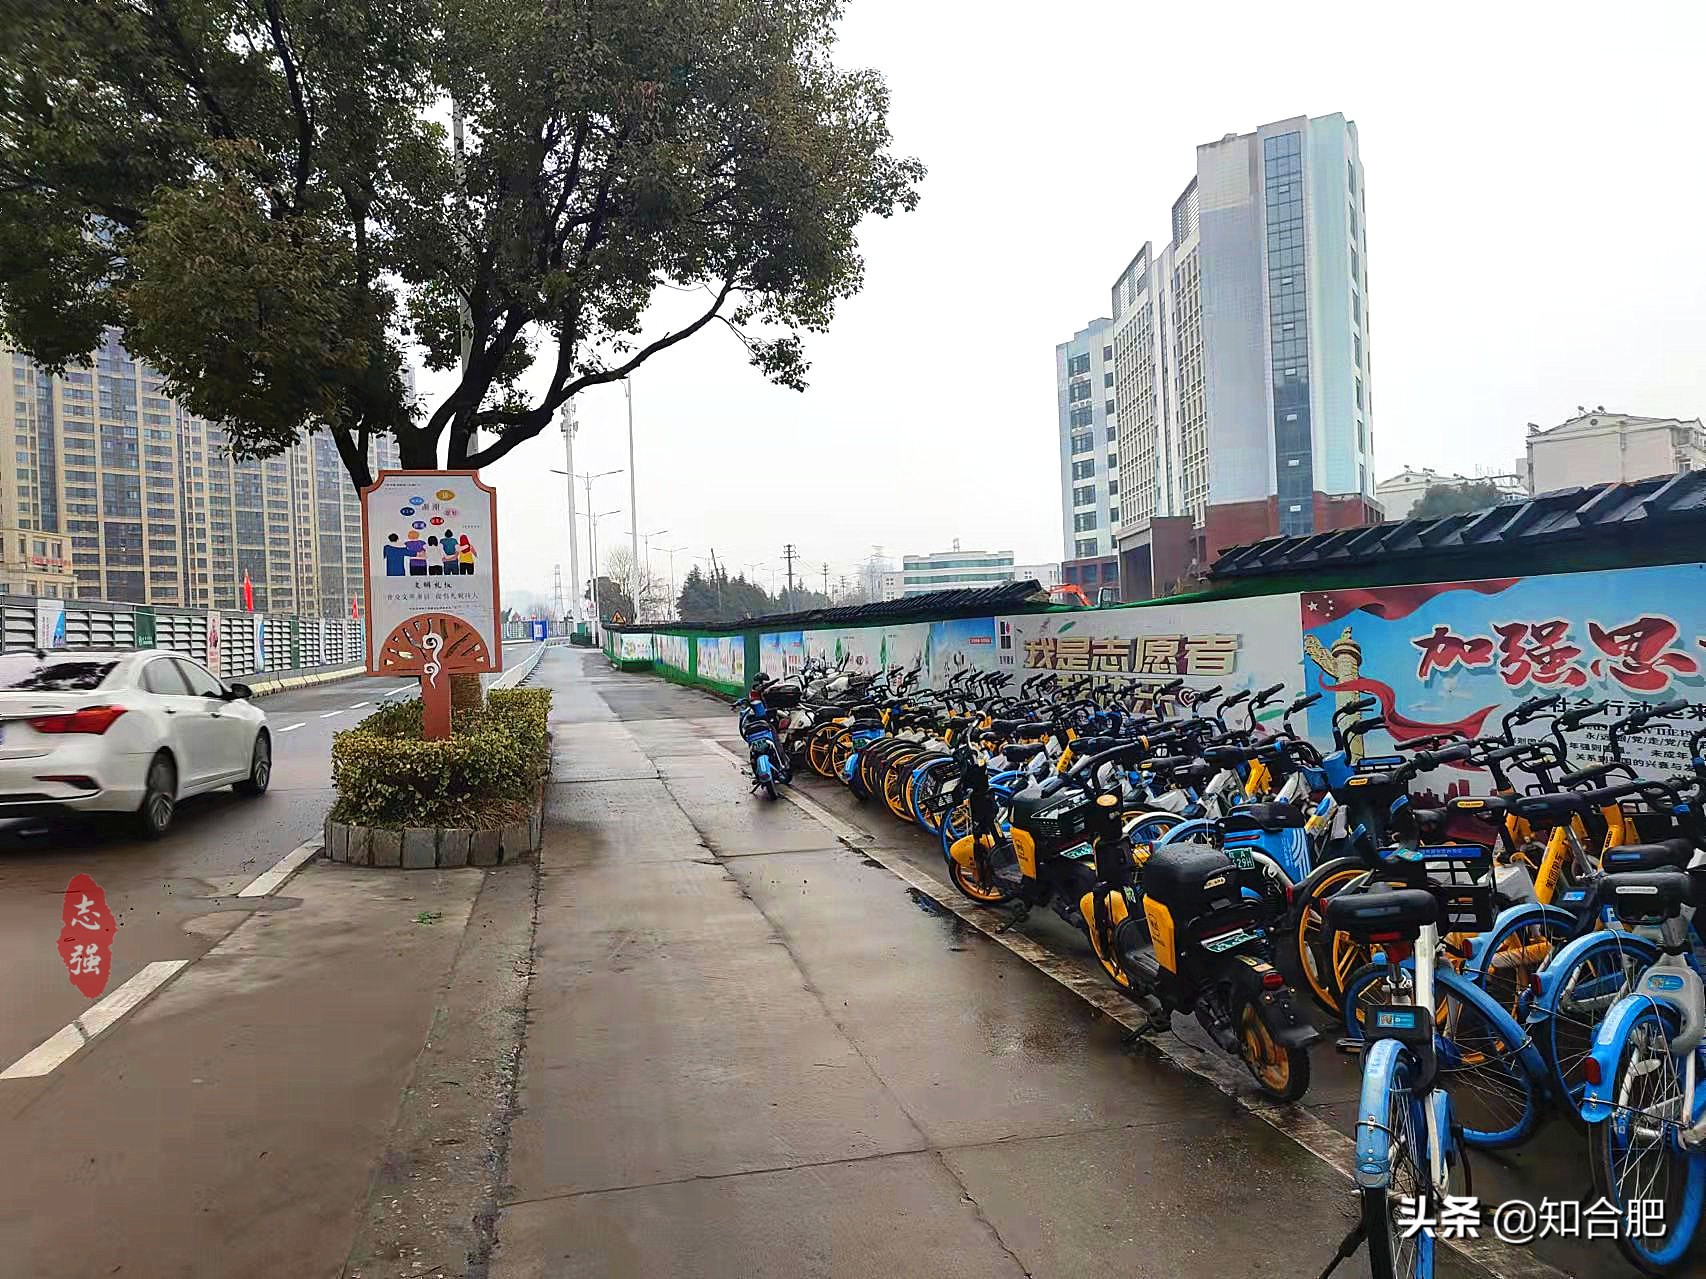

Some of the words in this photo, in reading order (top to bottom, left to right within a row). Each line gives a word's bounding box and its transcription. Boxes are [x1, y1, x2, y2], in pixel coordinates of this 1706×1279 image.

[1023, 633, 1239, 676] 我是志愿者
[1415, 618, 1706, 690] 加强思
